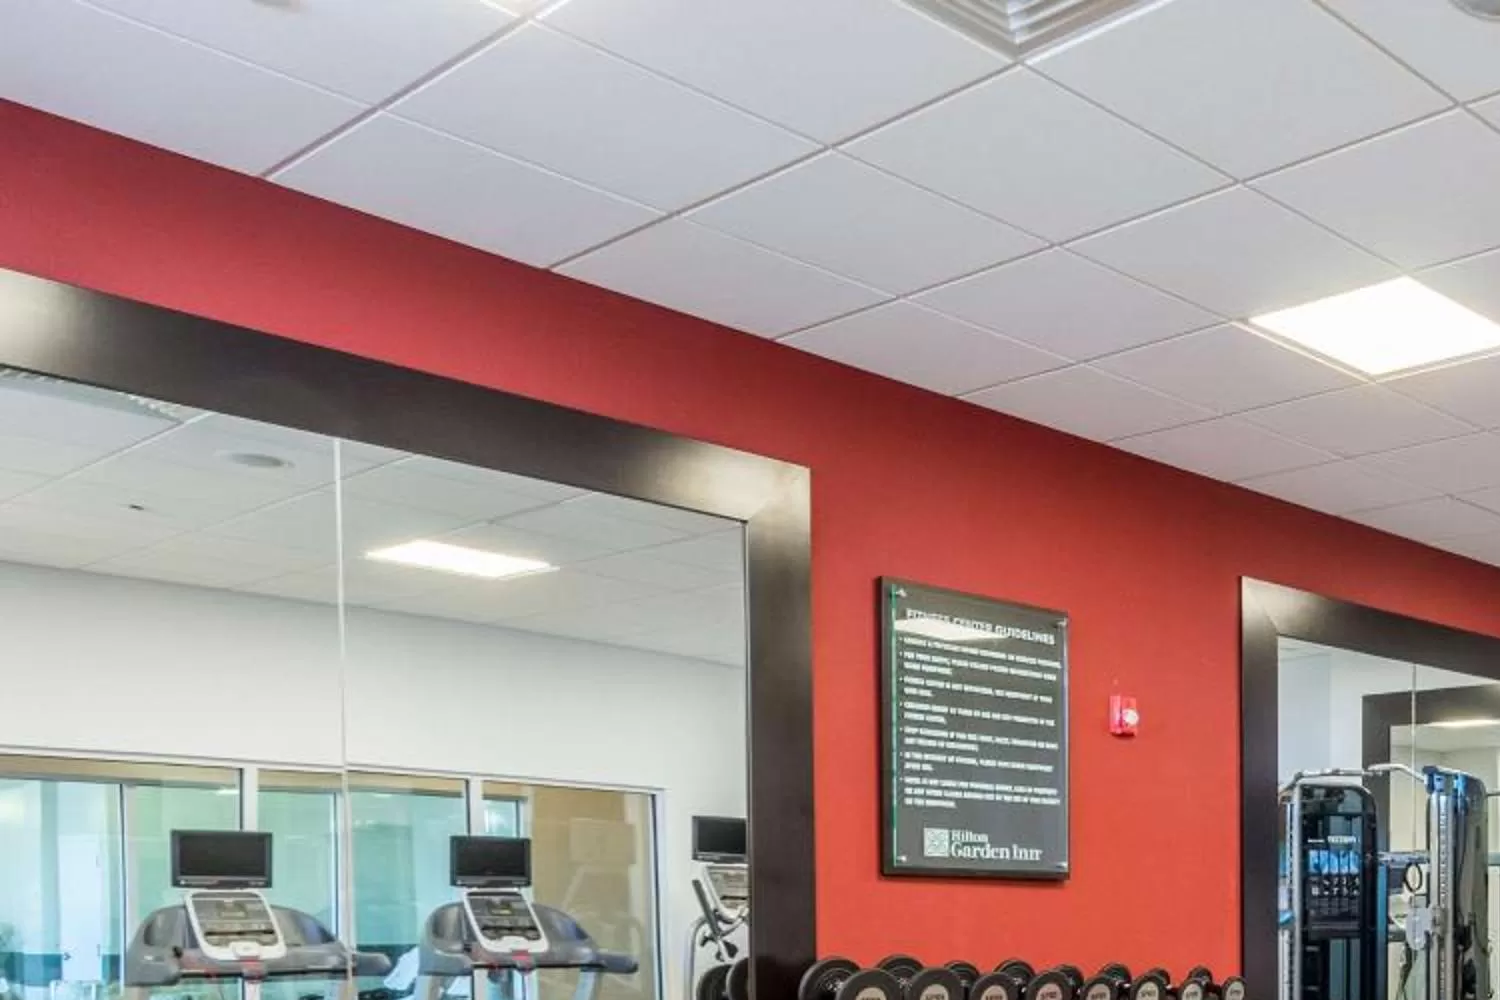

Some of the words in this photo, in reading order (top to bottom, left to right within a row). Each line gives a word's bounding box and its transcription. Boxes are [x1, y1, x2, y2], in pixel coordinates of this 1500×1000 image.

[995, 625, 1055, 645] GUIDELINES
[951, 828, 989, 842] Hilton
[951, 841, 1010, 859] Garden
[1012, 843, 1043, 861] Inn
